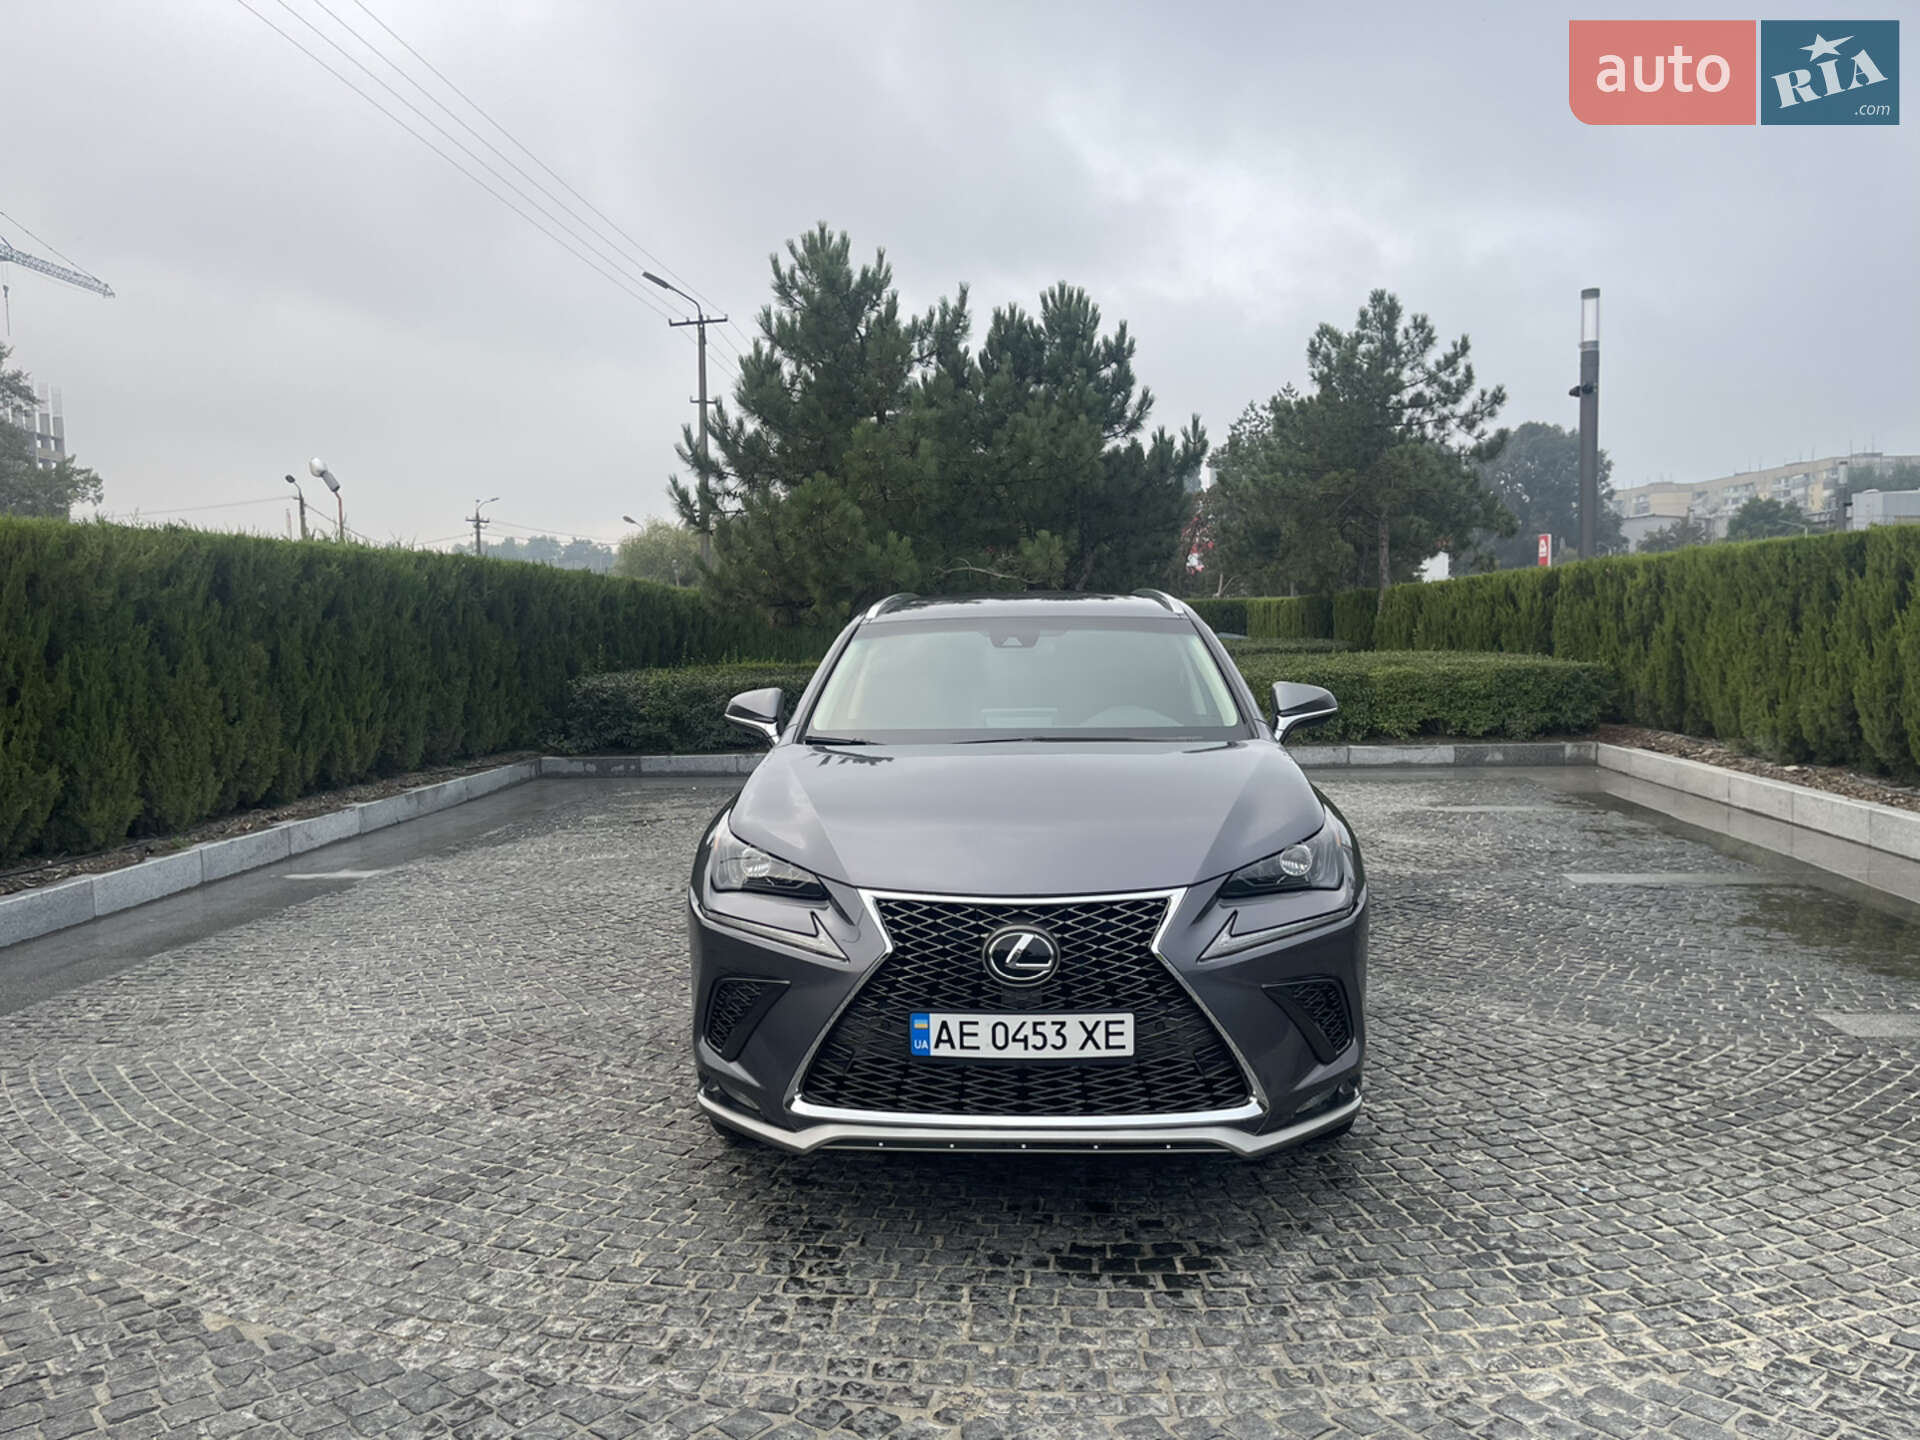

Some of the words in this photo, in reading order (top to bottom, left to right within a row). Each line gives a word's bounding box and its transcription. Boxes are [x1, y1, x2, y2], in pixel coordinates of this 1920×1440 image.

[914, 1040, 929, 1049] UA
[934, 1020, 980, 1050] AE
[991, 1021, 1067, 1051] 0453
[1078, 1020, 1126, 1050] XE
